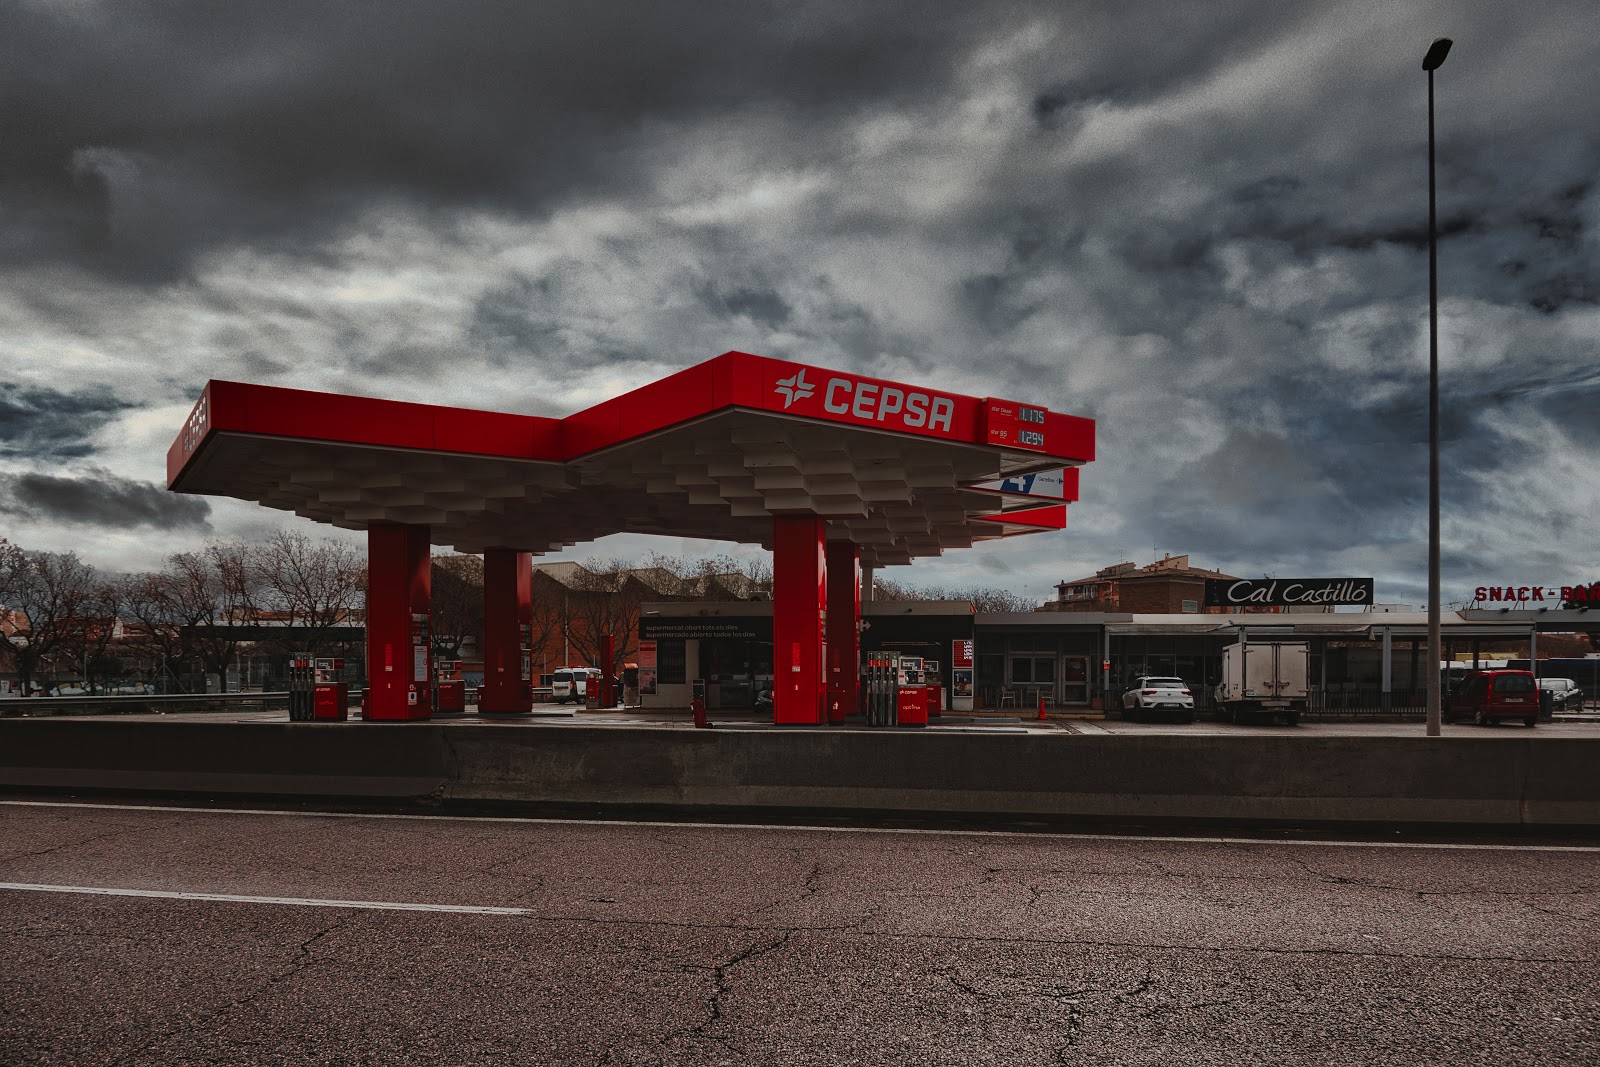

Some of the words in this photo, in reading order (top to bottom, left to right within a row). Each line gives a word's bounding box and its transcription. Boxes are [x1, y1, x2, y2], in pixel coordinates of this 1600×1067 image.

[823, 377, 955, 432] CEPSA
[1023, 408, 1044, 424] 1.175
[1022, 431, 1044, 446] 1.294
[1227, 580, 1277, 603] Cal
[1282, 580, 1367, 604] Castilló
